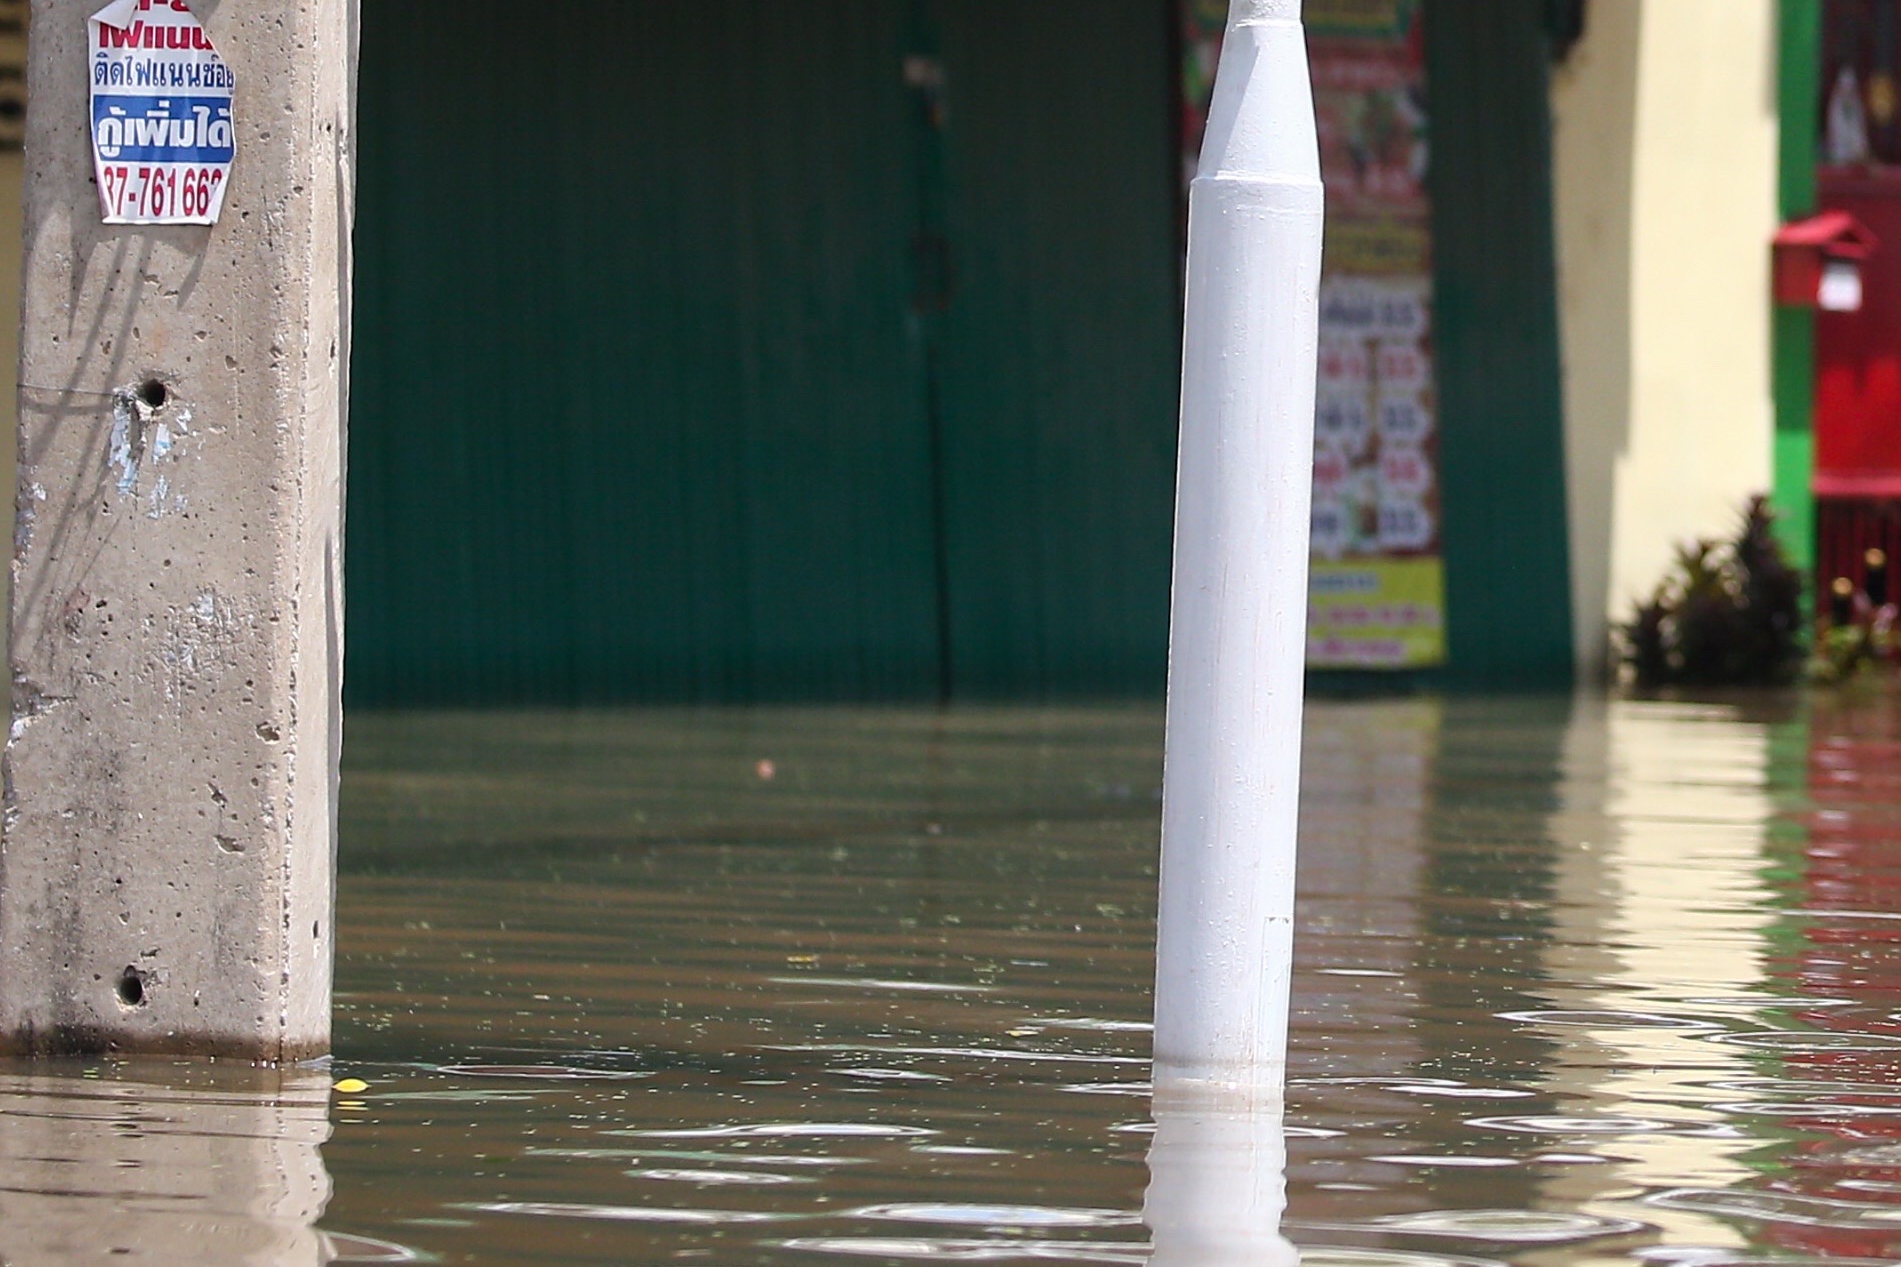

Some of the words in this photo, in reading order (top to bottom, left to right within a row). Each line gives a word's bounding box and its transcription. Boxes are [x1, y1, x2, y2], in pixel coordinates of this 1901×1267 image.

[98, 99, 231, 158] กู้เพิ่มได้
